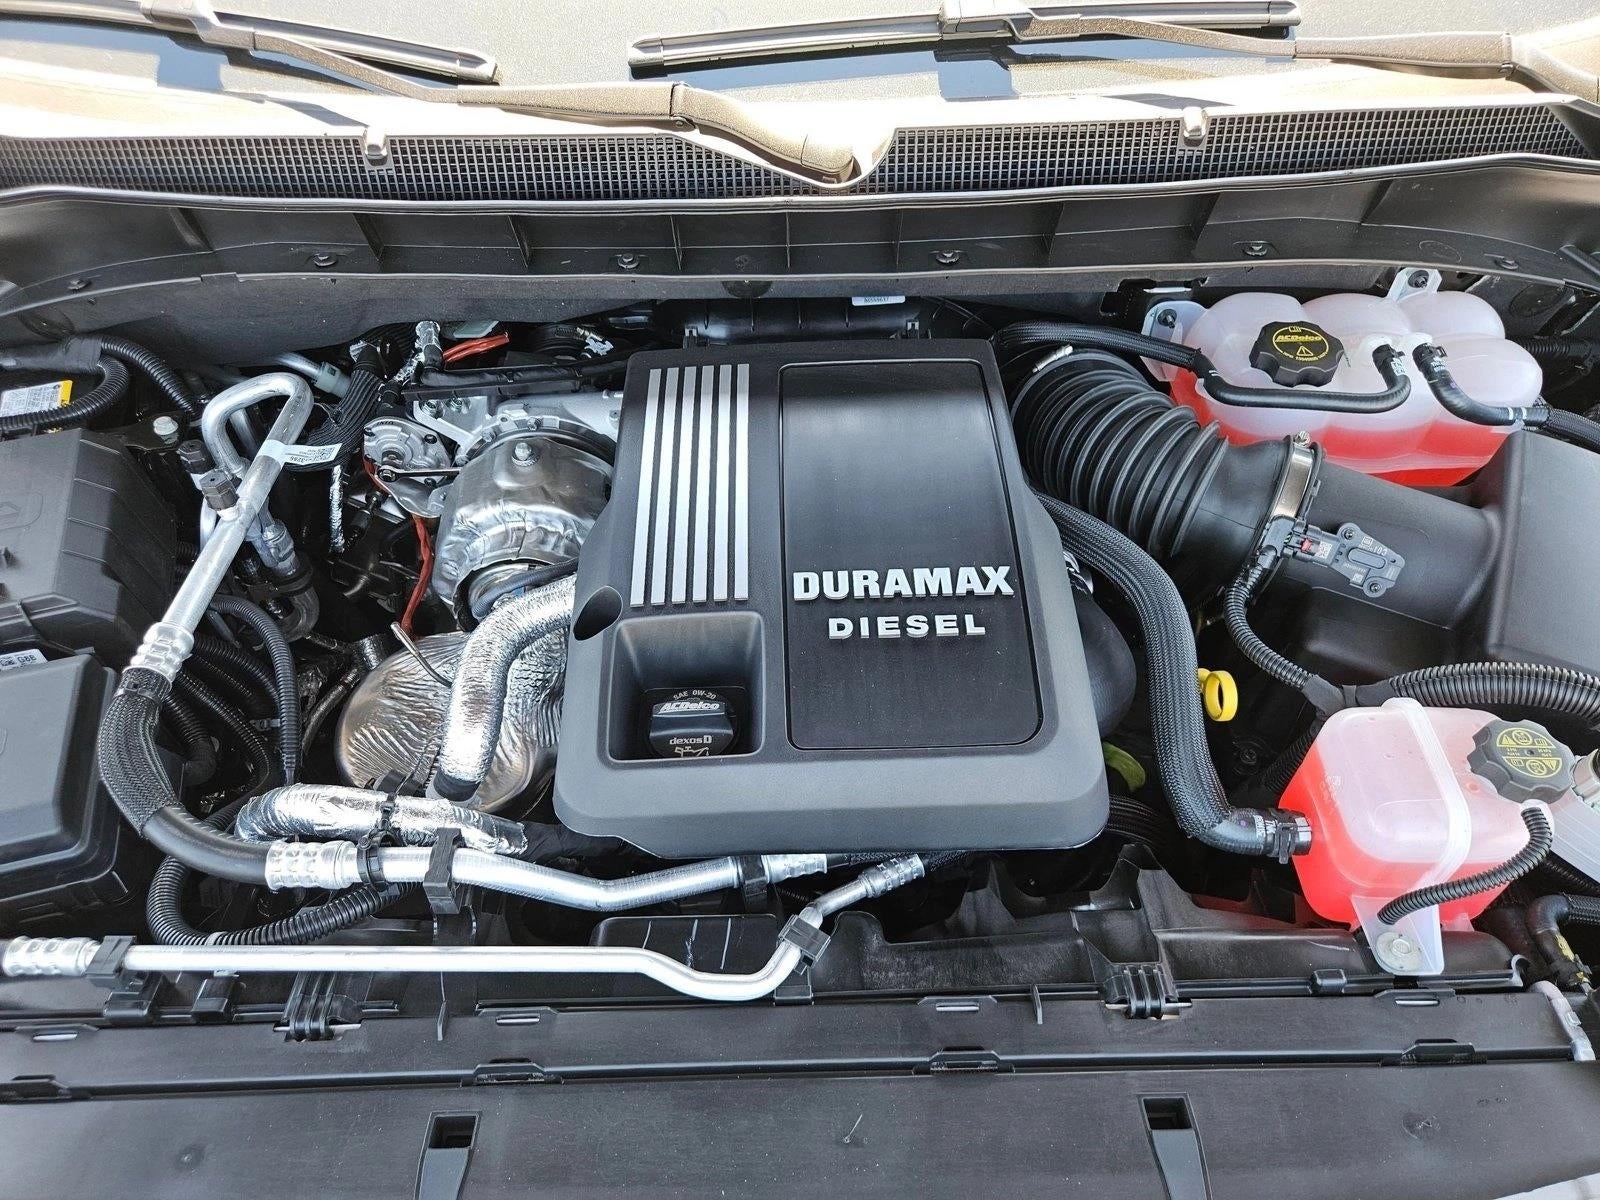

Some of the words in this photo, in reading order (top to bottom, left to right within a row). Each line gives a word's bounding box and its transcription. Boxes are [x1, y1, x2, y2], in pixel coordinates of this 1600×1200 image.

[1275, 334, 1322, 343] ACDelco
[793, 566, 1014, 600] DURAMAX
[828, 614, 986, 639] DIESEL
[673, 691, 689, 700] SAE
[692, 690, 716, 700] 0W-20
[658, 702, 720, 713] ACDelco
